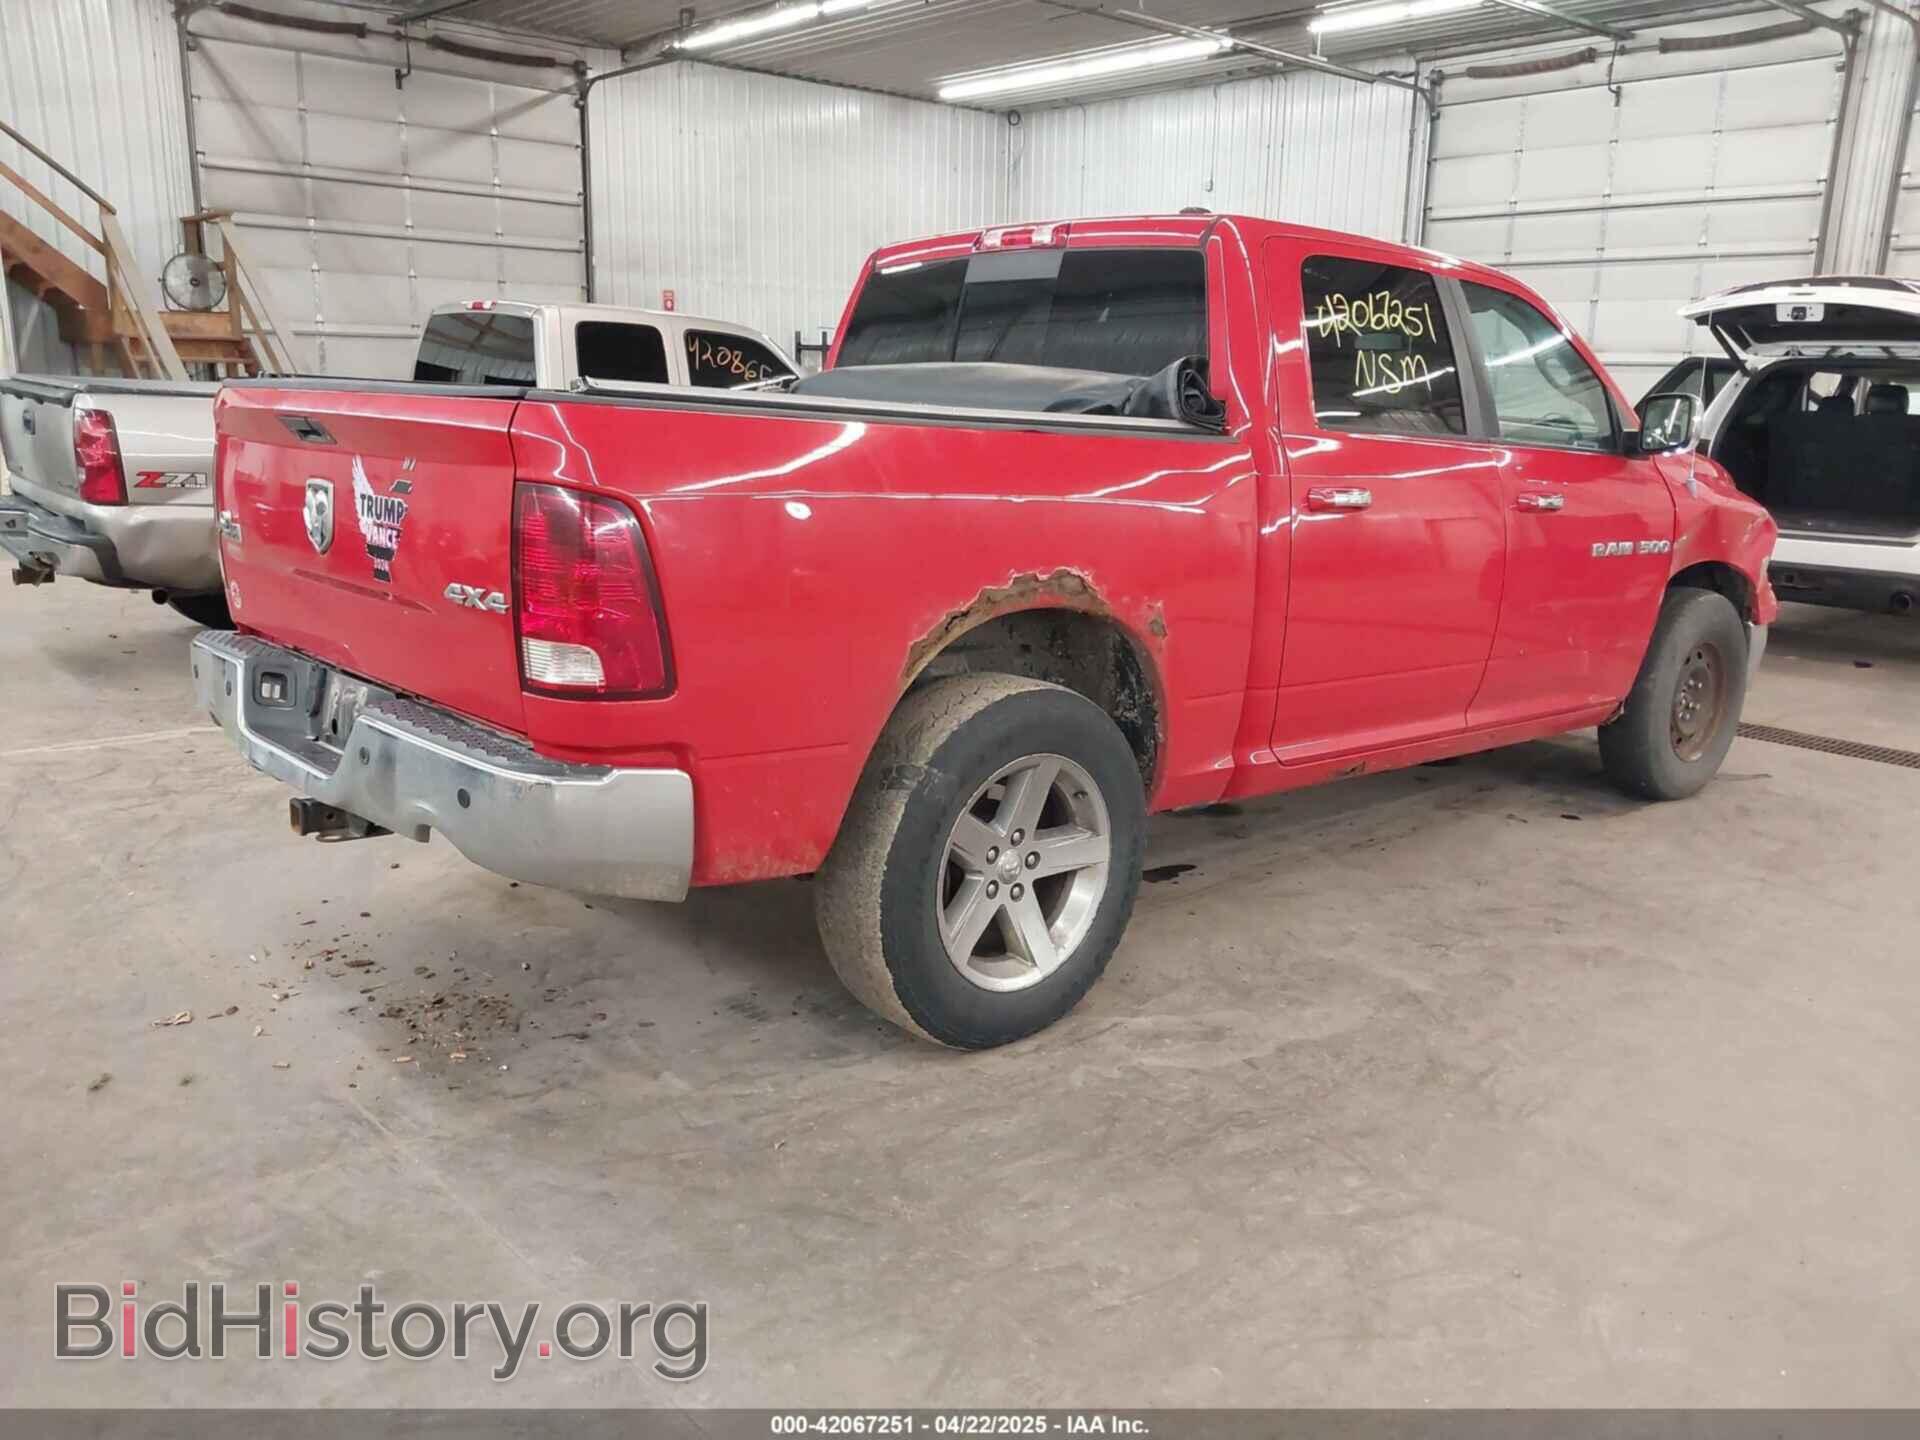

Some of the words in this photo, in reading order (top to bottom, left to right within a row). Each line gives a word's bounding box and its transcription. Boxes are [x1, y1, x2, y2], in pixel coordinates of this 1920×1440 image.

[1315, 290, 1437, 348] 42067251
[134, 472, 207, 488] Z71
[360, 493, 408, 525] TRUMP
[367, 524, 399, 550] VANCE
[1592, 542, 1633, 557] RAM
